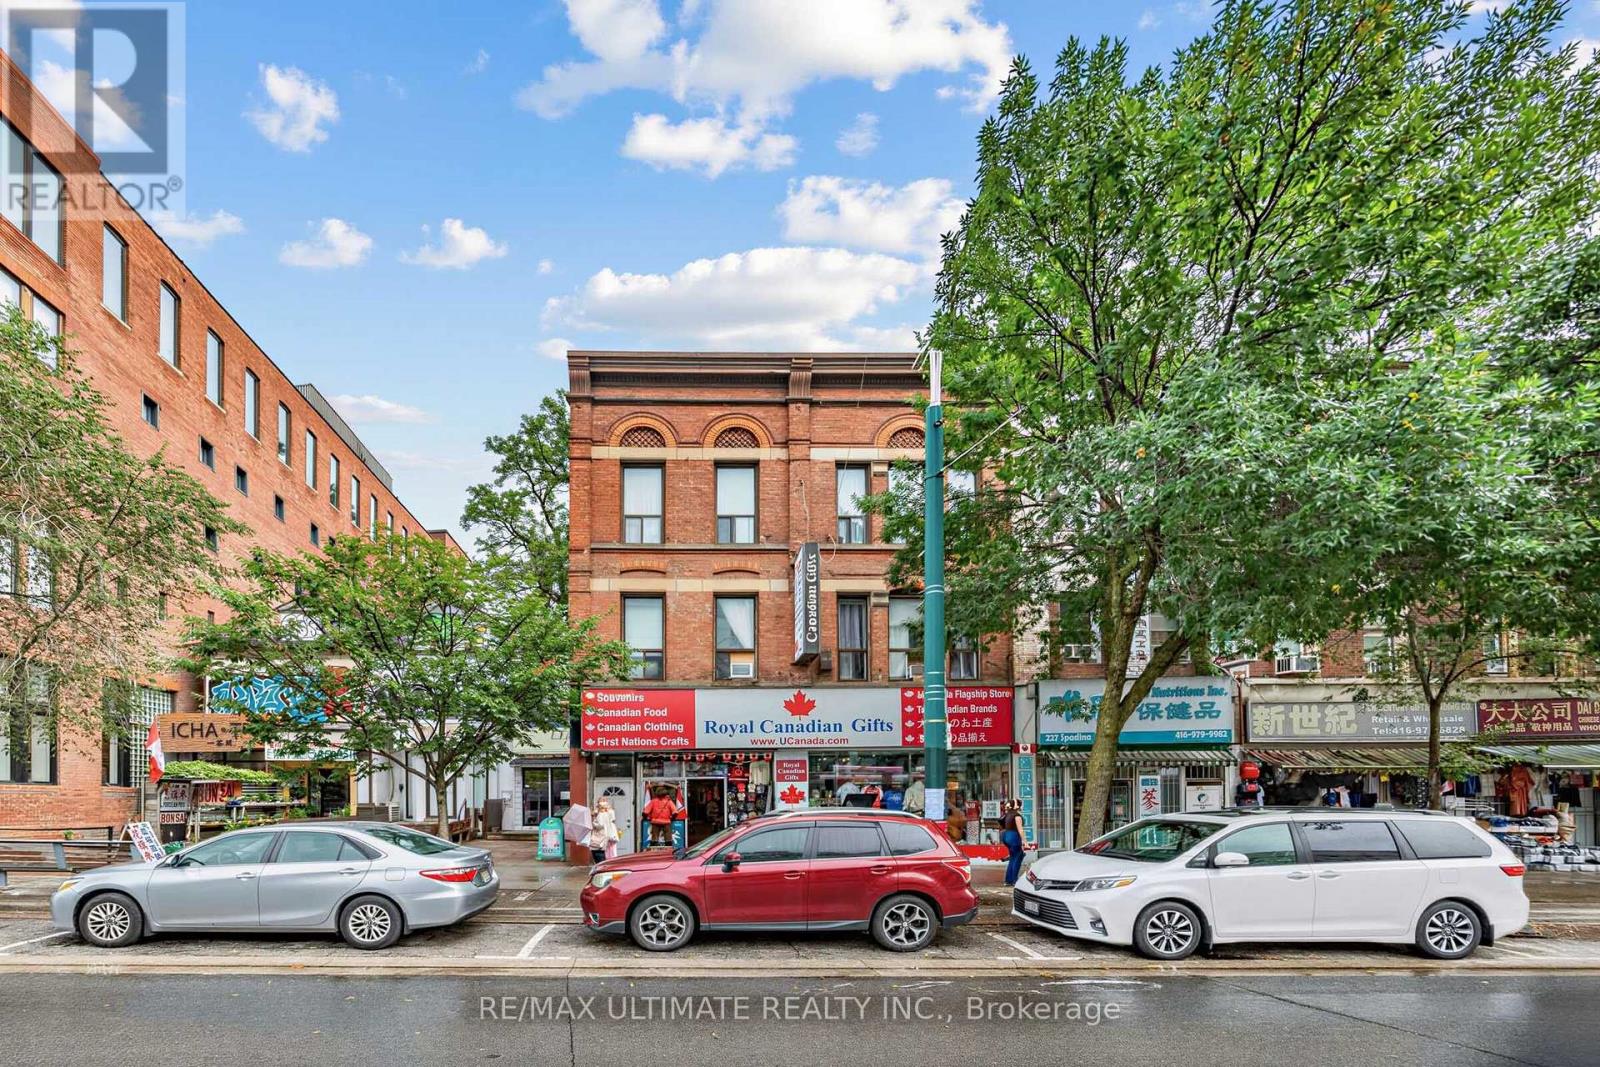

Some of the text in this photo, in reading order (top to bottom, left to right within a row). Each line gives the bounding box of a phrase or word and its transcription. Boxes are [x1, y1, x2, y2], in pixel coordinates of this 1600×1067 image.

[955, 689, 988, 700] Flagship
[989, 689, 1009, 699] Store
[1207, 685, 1228, 697] Inc.
[597, 692, 645, 703] Souvenirs
[597, 708, 668, 718] Canadian Food
[970, 704, 998, 714] Brands
[1136, 701, 1222, 721] 保健品
[1485, 701, 1572, 723] 大大公司
[1577, 701, 1592, 715] DAI
[1252, 703, 1359, 737] 新世紀
[1413, 714, 1464, 724] Whesale
[171, 722, 219, 739] ICHA
[597, 722, 684, 733] Canadian Clothing
[704, 717, 894, 738] Royal Canadian Gifts
[597, 736, 690, 747] First Nations Crafts
[1045, 733, 1092, 743] 227 Spadina
